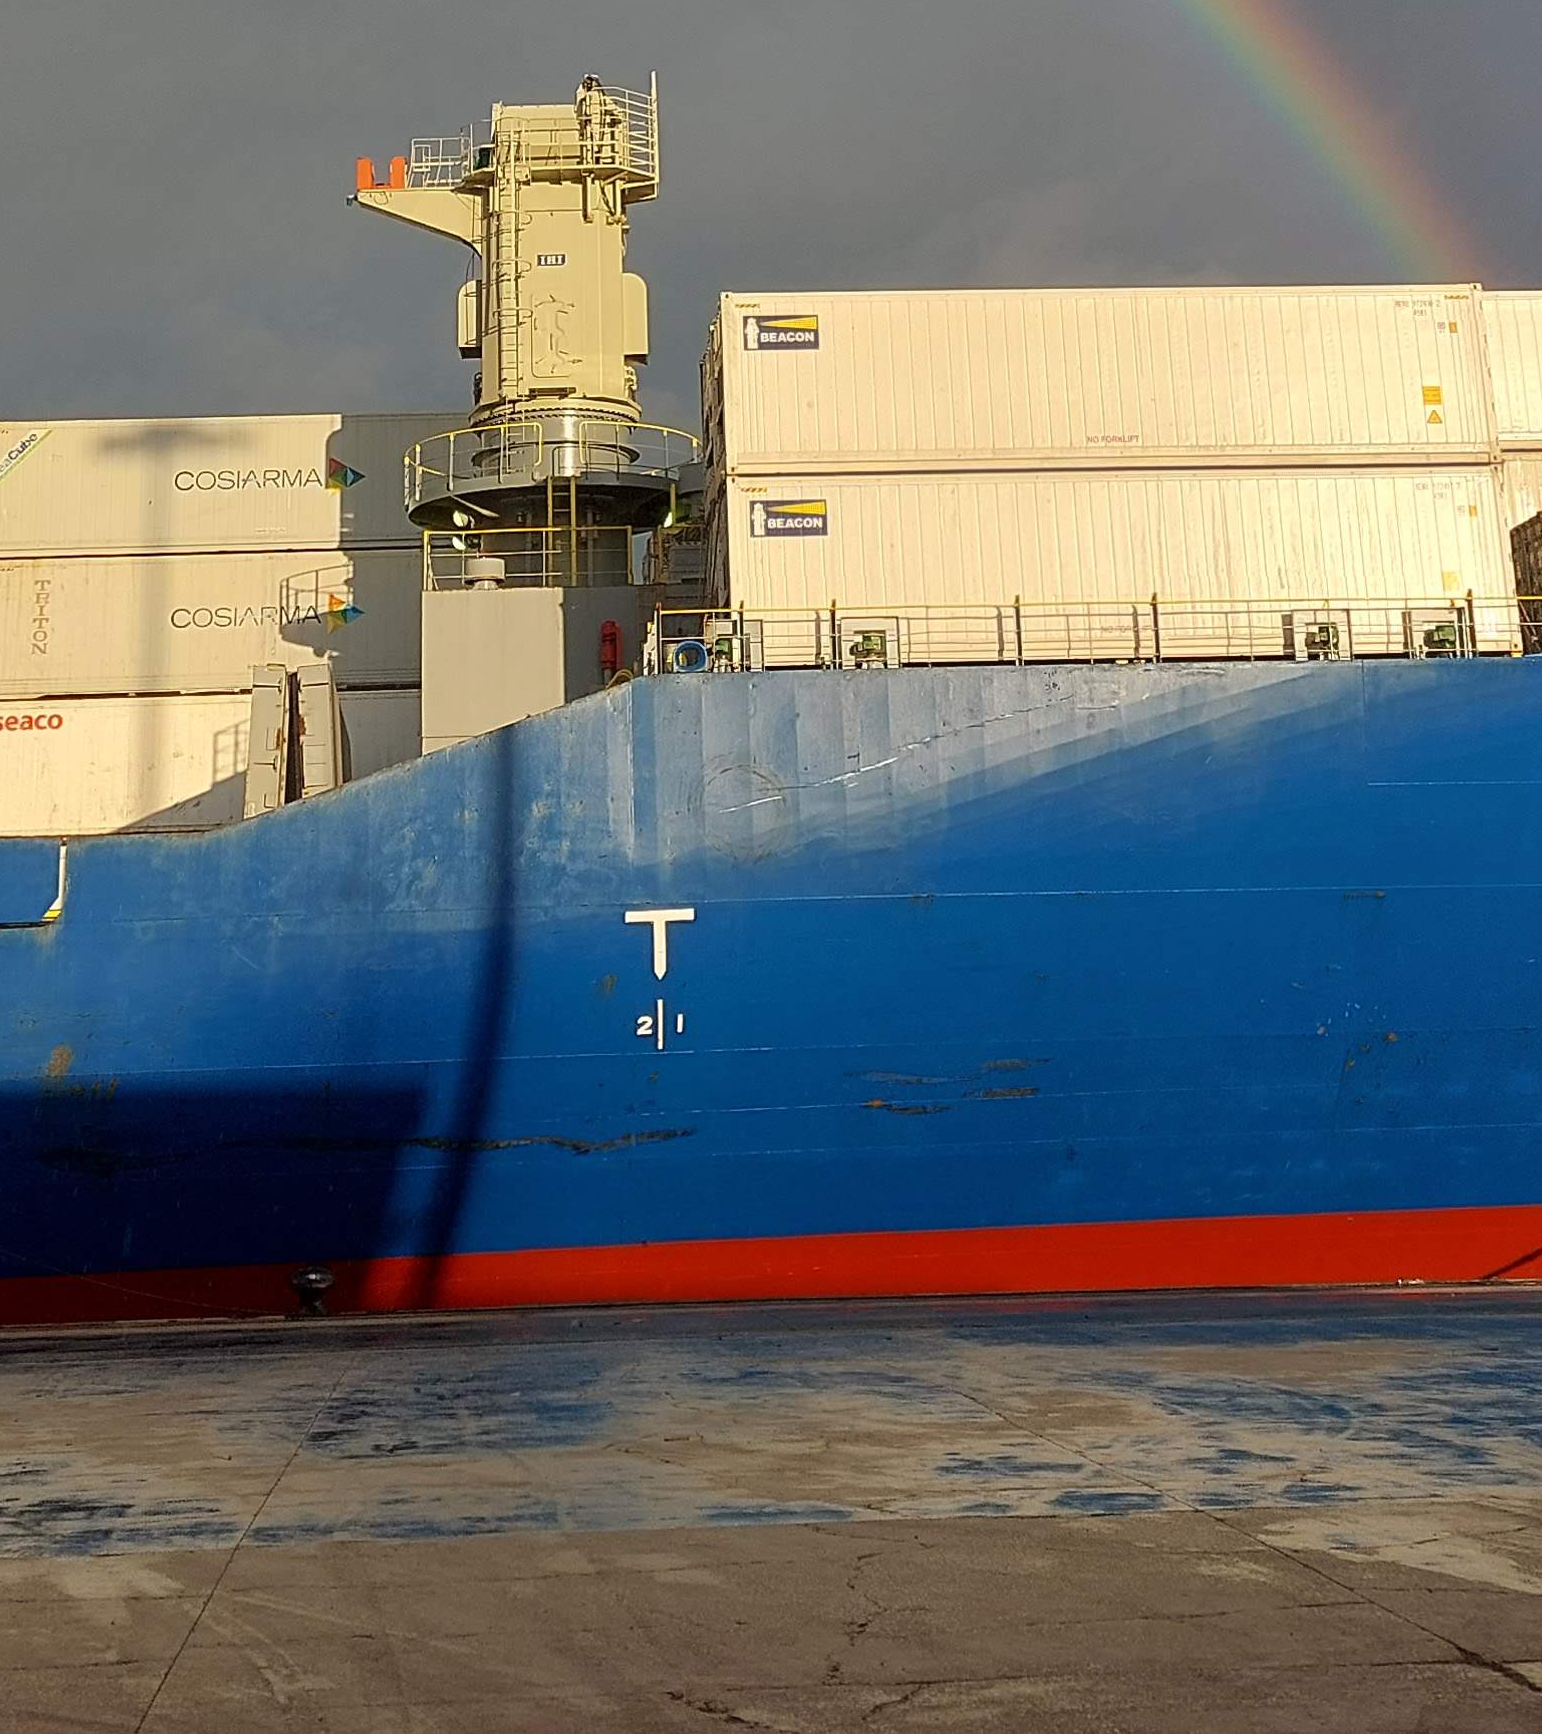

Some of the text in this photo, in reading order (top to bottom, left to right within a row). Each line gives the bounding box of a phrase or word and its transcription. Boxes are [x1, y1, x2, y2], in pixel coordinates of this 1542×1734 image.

[760, 331, 815, 343] BEACON
[1100, 434, 1140, 443] FORKLIFT
[173, 468, 323, 492] COSIARMA
[767, 517, 824, 529] BEACON
[31, 579, 52, 656] TRITON
[170, 605, 323, 629] COSIARMA
[636, 1016, 653, 1035] 2
